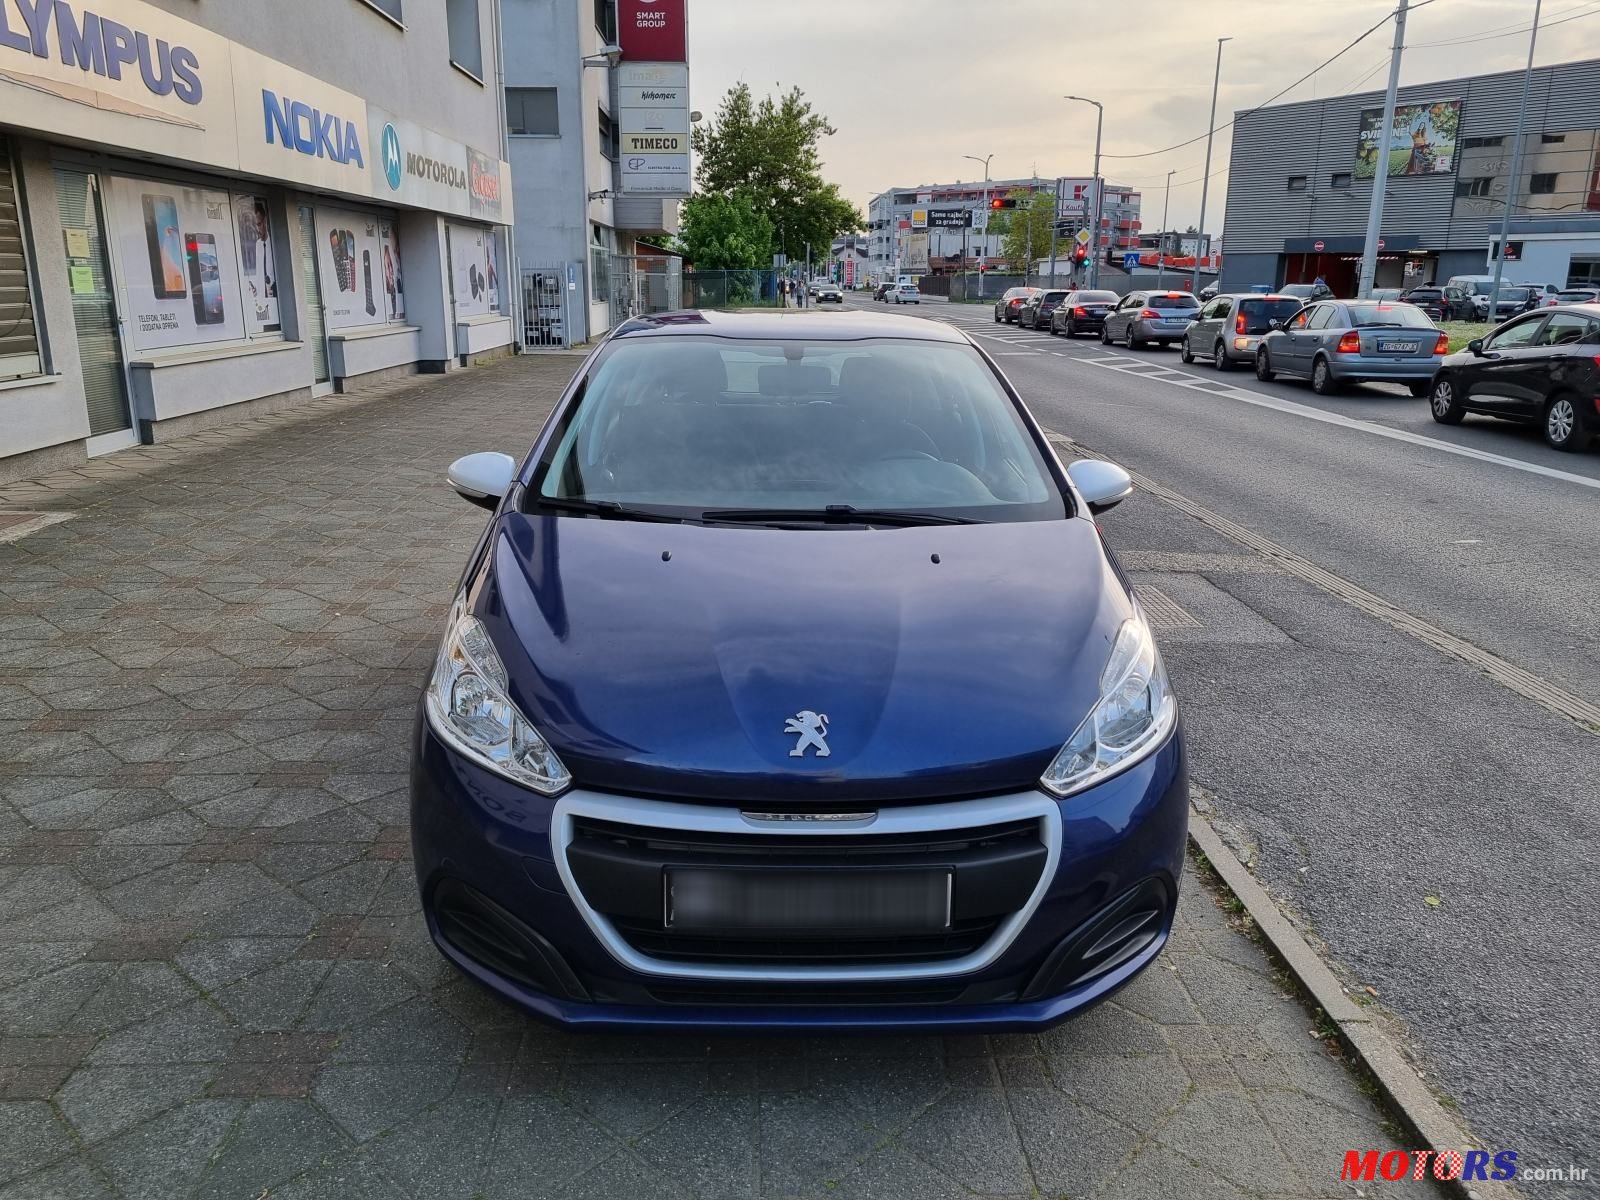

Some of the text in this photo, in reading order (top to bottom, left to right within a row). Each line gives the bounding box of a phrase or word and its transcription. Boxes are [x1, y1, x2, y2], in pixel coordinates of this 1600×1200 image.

[636, 12, 666, 20] SMART
[636, 20, 666, 28] GROUP
[262, 88, 364, 169] NOKIA
[631, 137, 678, 150] TIMECO
[406, 152, 466, 190] MOTOROLA
